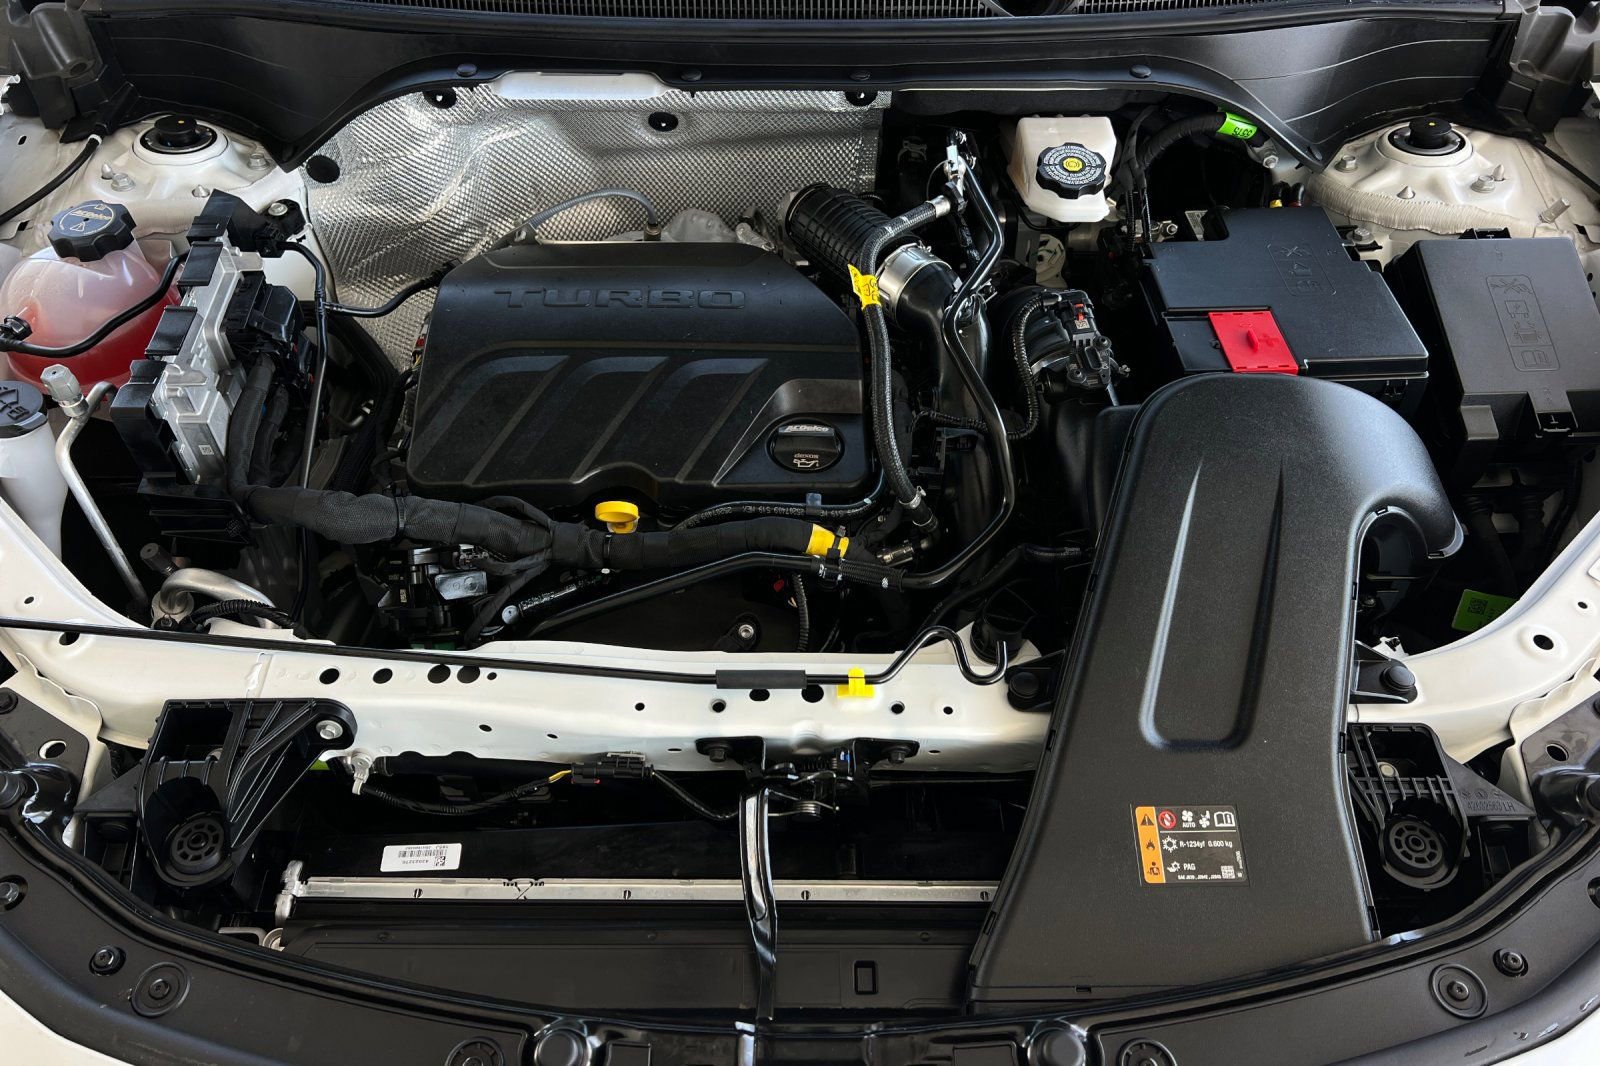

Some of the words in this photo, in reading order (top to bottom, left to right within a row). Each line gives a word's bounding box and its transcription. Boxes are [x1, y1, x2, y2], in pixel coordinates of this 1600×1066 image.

[494, 288, 745, 310] TURBO
[784, 424, 829, 433] ACDelco
[1182, 821, 1196, 829] AUTO
[1225, 840, 1233, 849] kg
